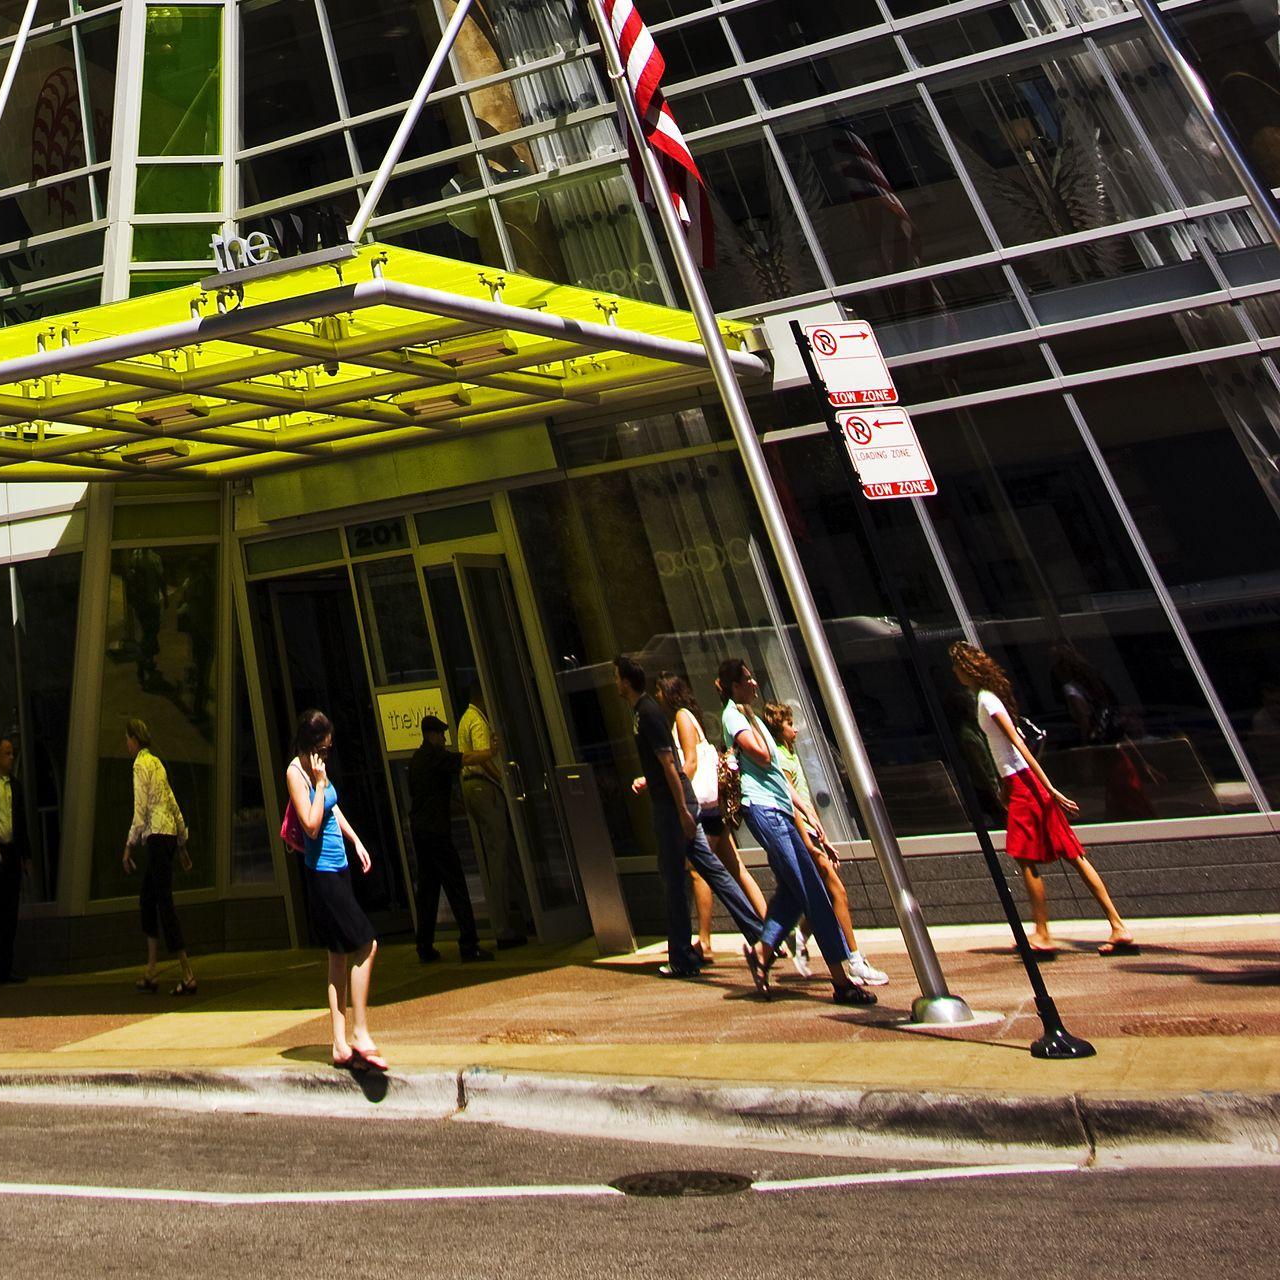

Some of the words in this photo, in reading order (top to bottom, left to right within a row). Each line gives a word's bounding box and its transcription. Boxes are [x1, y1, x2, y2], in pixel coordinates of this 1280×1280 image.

[832, 392, 857, 404] TOW
[860, 389, 892, 402] ZONE
[854, 450, 888, 462] LOADING
[891, 448, 912, 459] ZONE
[866, 483, 894, 497] TOW
[898, 480, 931, 494] ZONE
[354, 522, 405, 549] 201
